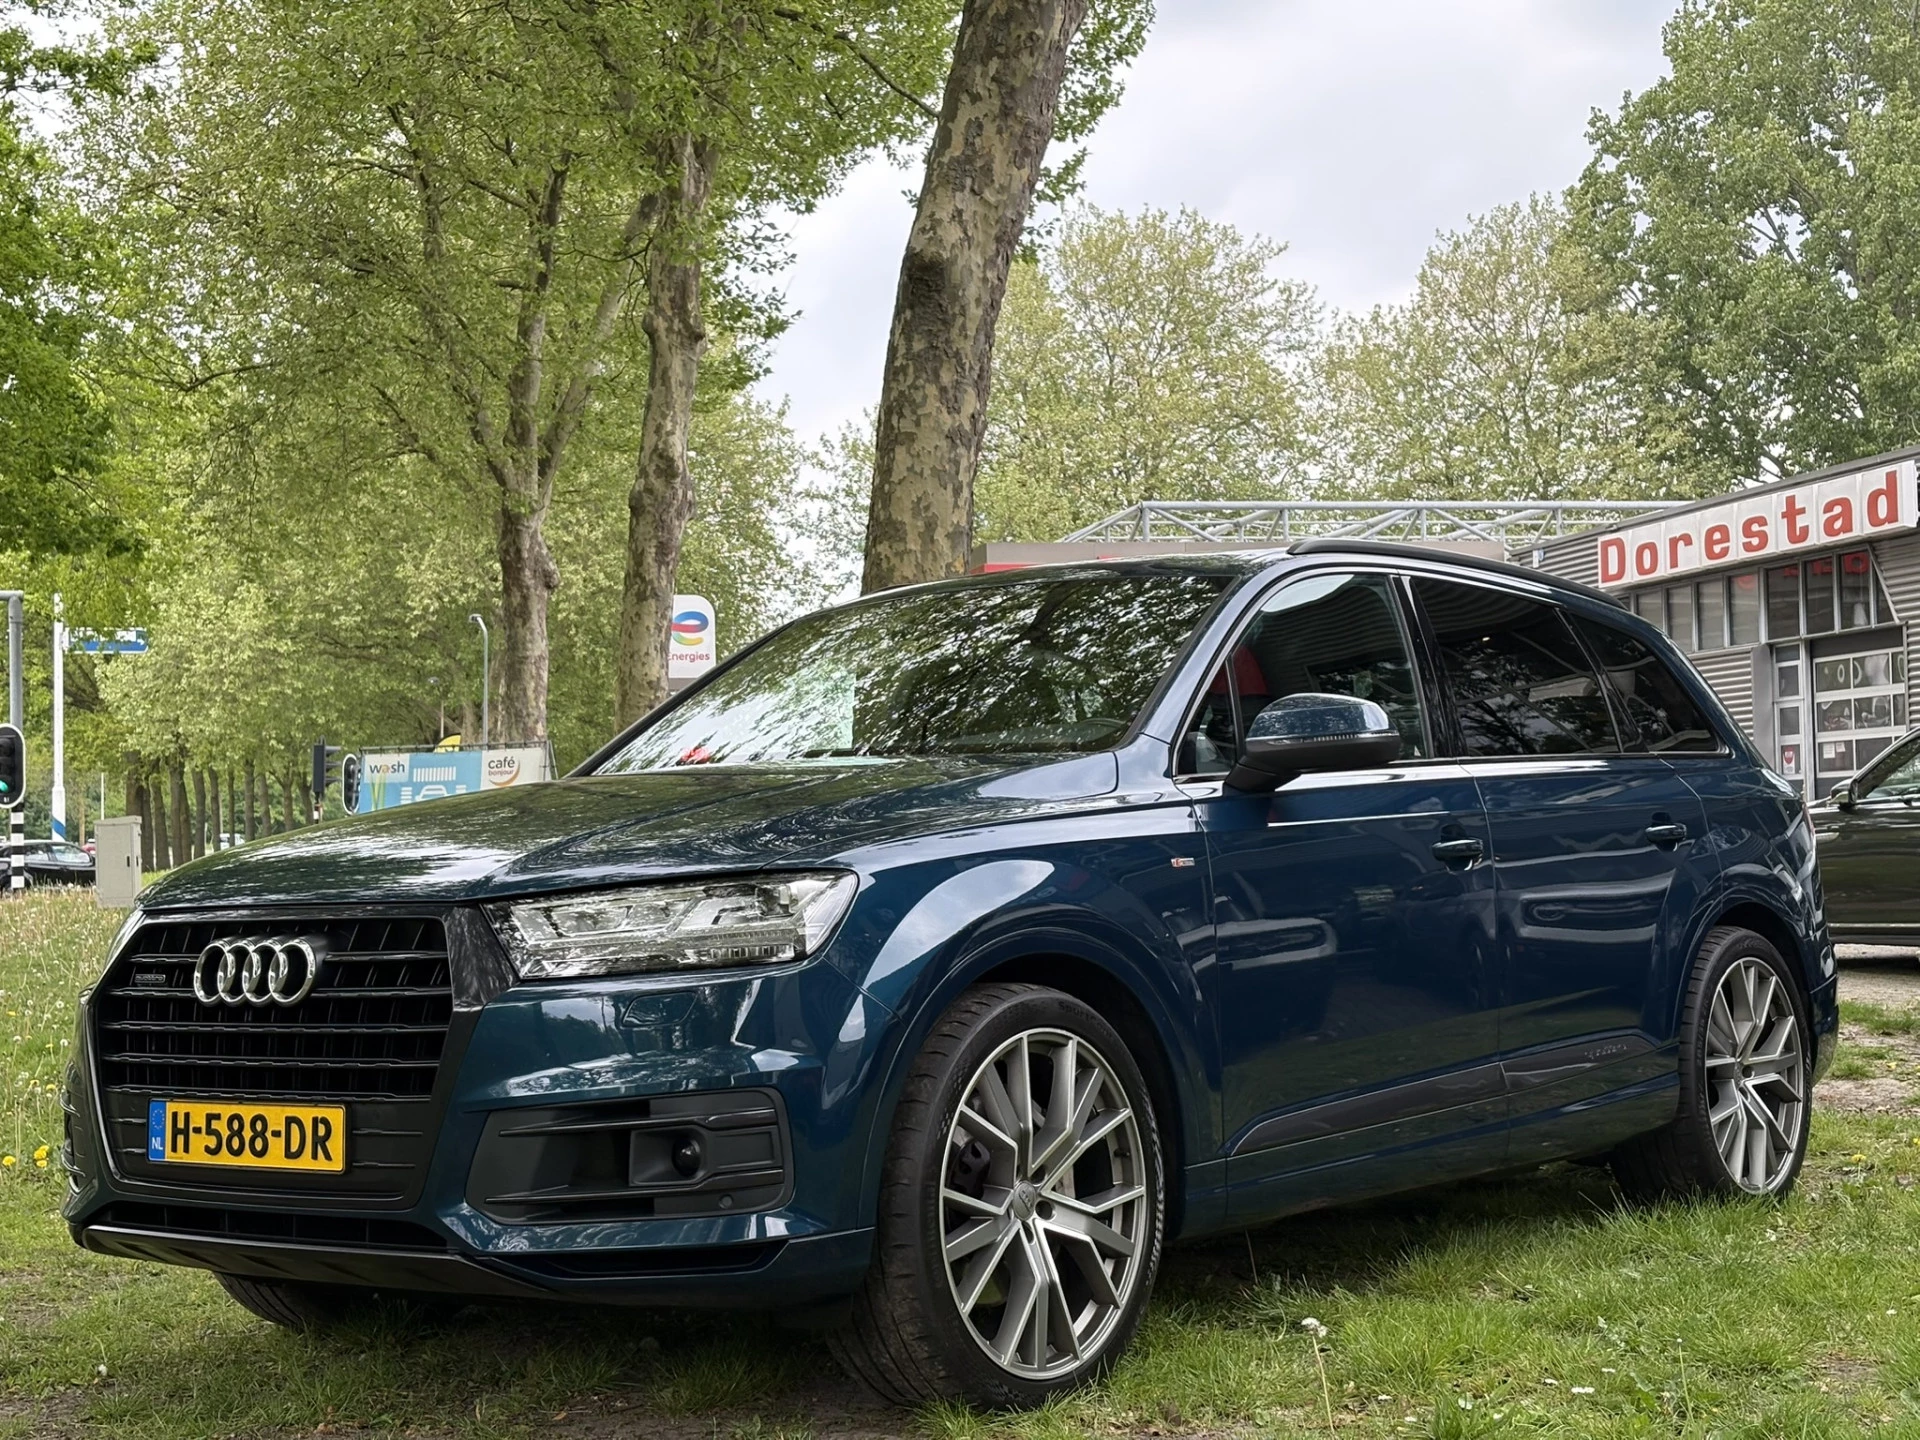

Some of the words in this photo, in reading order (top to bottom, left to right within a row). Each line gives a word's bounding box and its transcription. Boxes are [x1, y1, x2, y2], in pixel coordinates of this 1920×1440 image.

[1600, 469, 1899, 583] Dorestad
[369, 760, 405, 774] wash
[488, 756, 515, 769] café
[488, 768, 514, 777] bonjour
[171, 1111, 333, 1162] H-588-DR
[151, 1137, 164, 1151] NL
